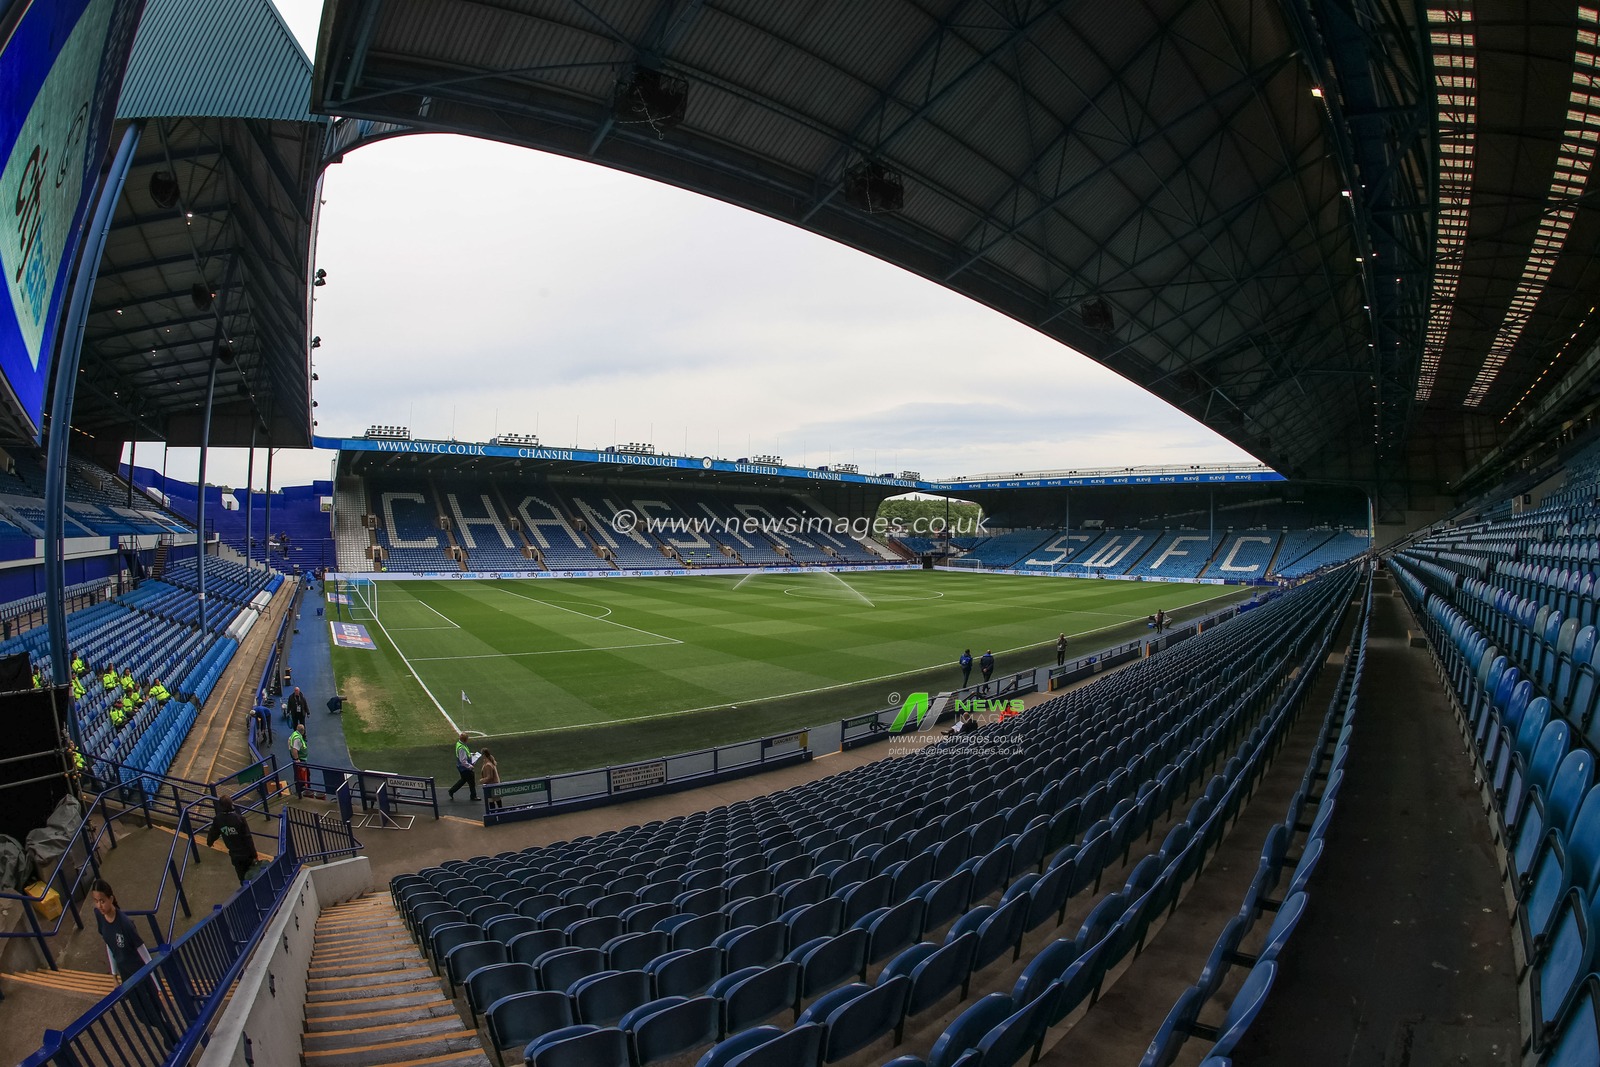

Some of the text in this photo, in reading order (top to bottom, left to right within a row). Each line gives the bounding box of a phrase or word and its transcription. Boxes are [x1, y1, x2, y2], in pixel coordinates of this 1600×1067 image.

[377, 441, 486, 456] WWW.SWFC.CO.UK
[518, 448, 573, 460] CHANSIRI
[598, 453, 678, 467] HILLSBOROUGH
[734, 463, 778, 475] SHEFFIELD
[807, 470, 842, 481] CHANSIRI
[389, 779, 417, 788] GANGWAY
